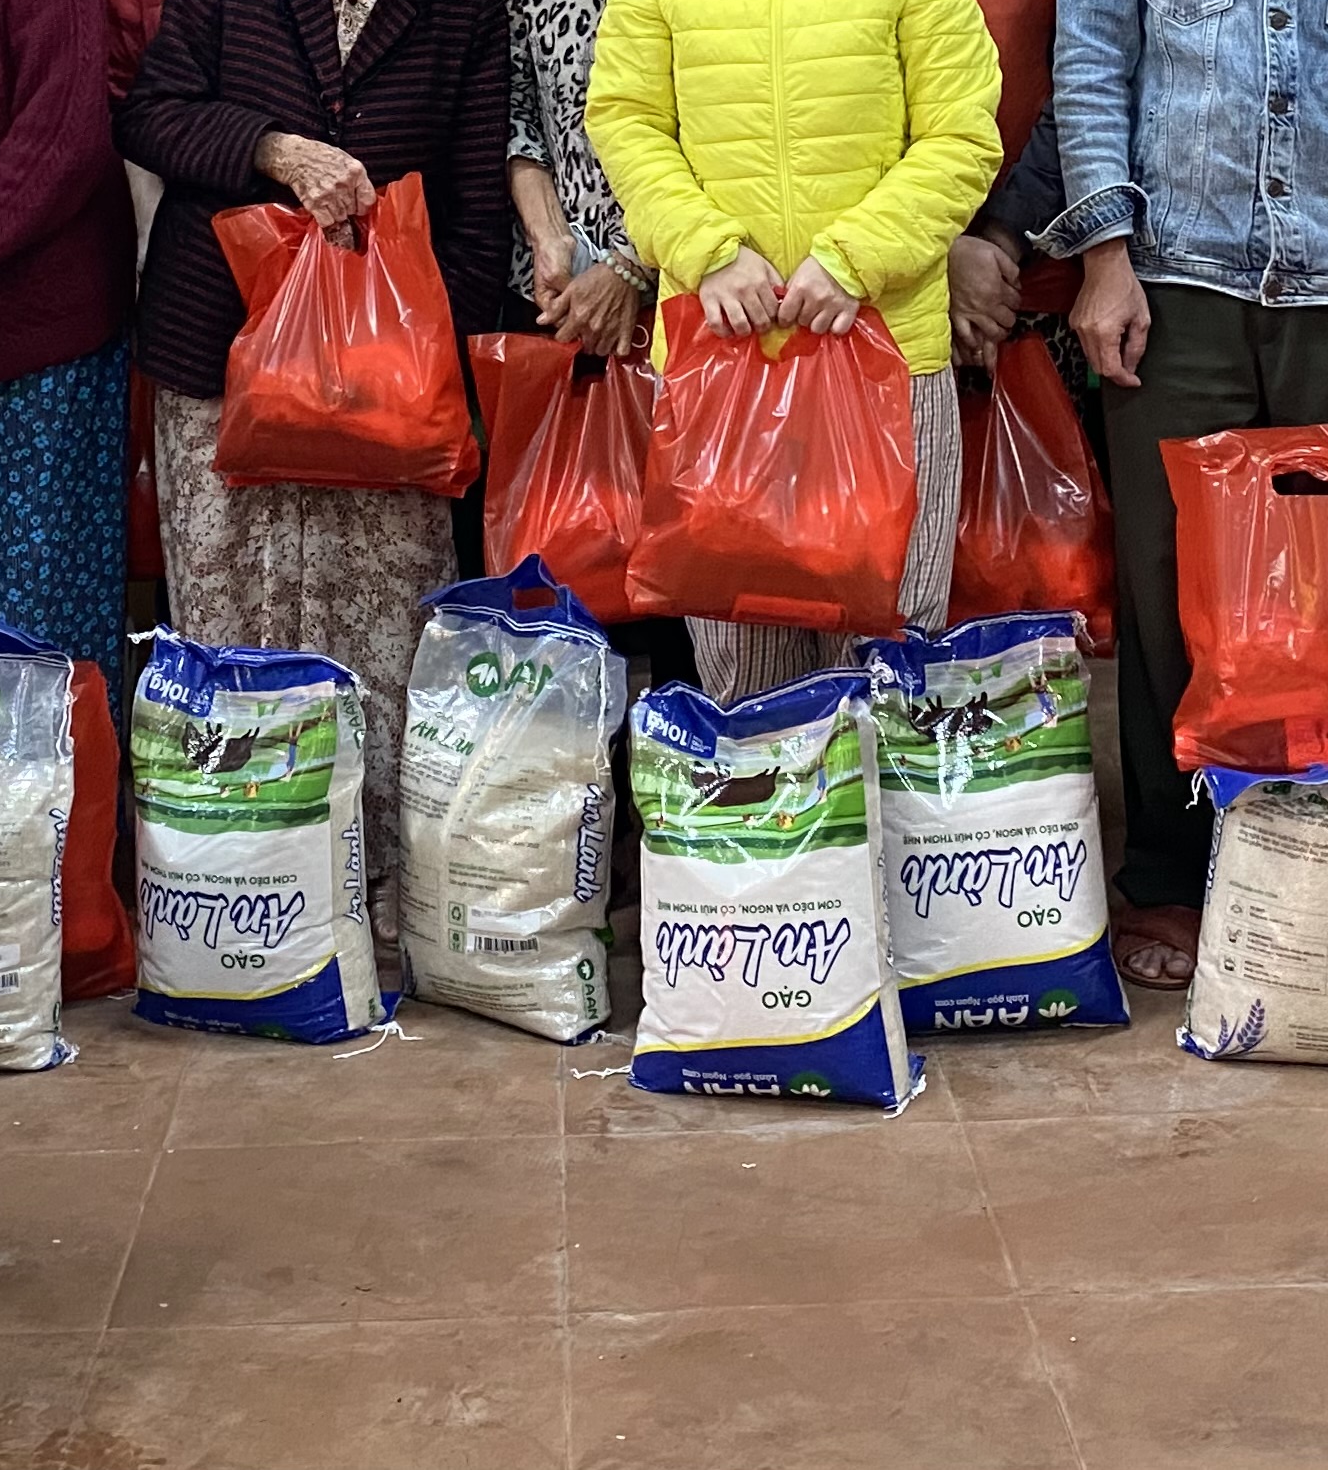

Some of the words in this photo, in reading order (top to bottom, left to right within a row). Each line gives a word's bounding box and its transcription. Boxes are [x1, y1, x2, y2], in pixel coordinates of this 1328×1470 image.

[148, 672, 190, 704] 10kg
[574, 824, 606, 904] Lành
[1024, 839, 1087, 902] An
[900, 848, 1023, 920] Lành
[140, 877, 228, 950] Lành
[230, 890, 305, 950] An
[720, 904, 736, 917] CÓ
[775, 903, 790, 915] VÀ
[817, 899, 842, 912] CƠM
[1016, 903, 1062, 929] GẠO
[220, 949, 266, 969] GẠO
[656, 921, 772, 989] Lành
[772, 917, 851, 986] An
[583, 983, 600, 1021] AAN
[761, 985, 812, 1010] GẠO
